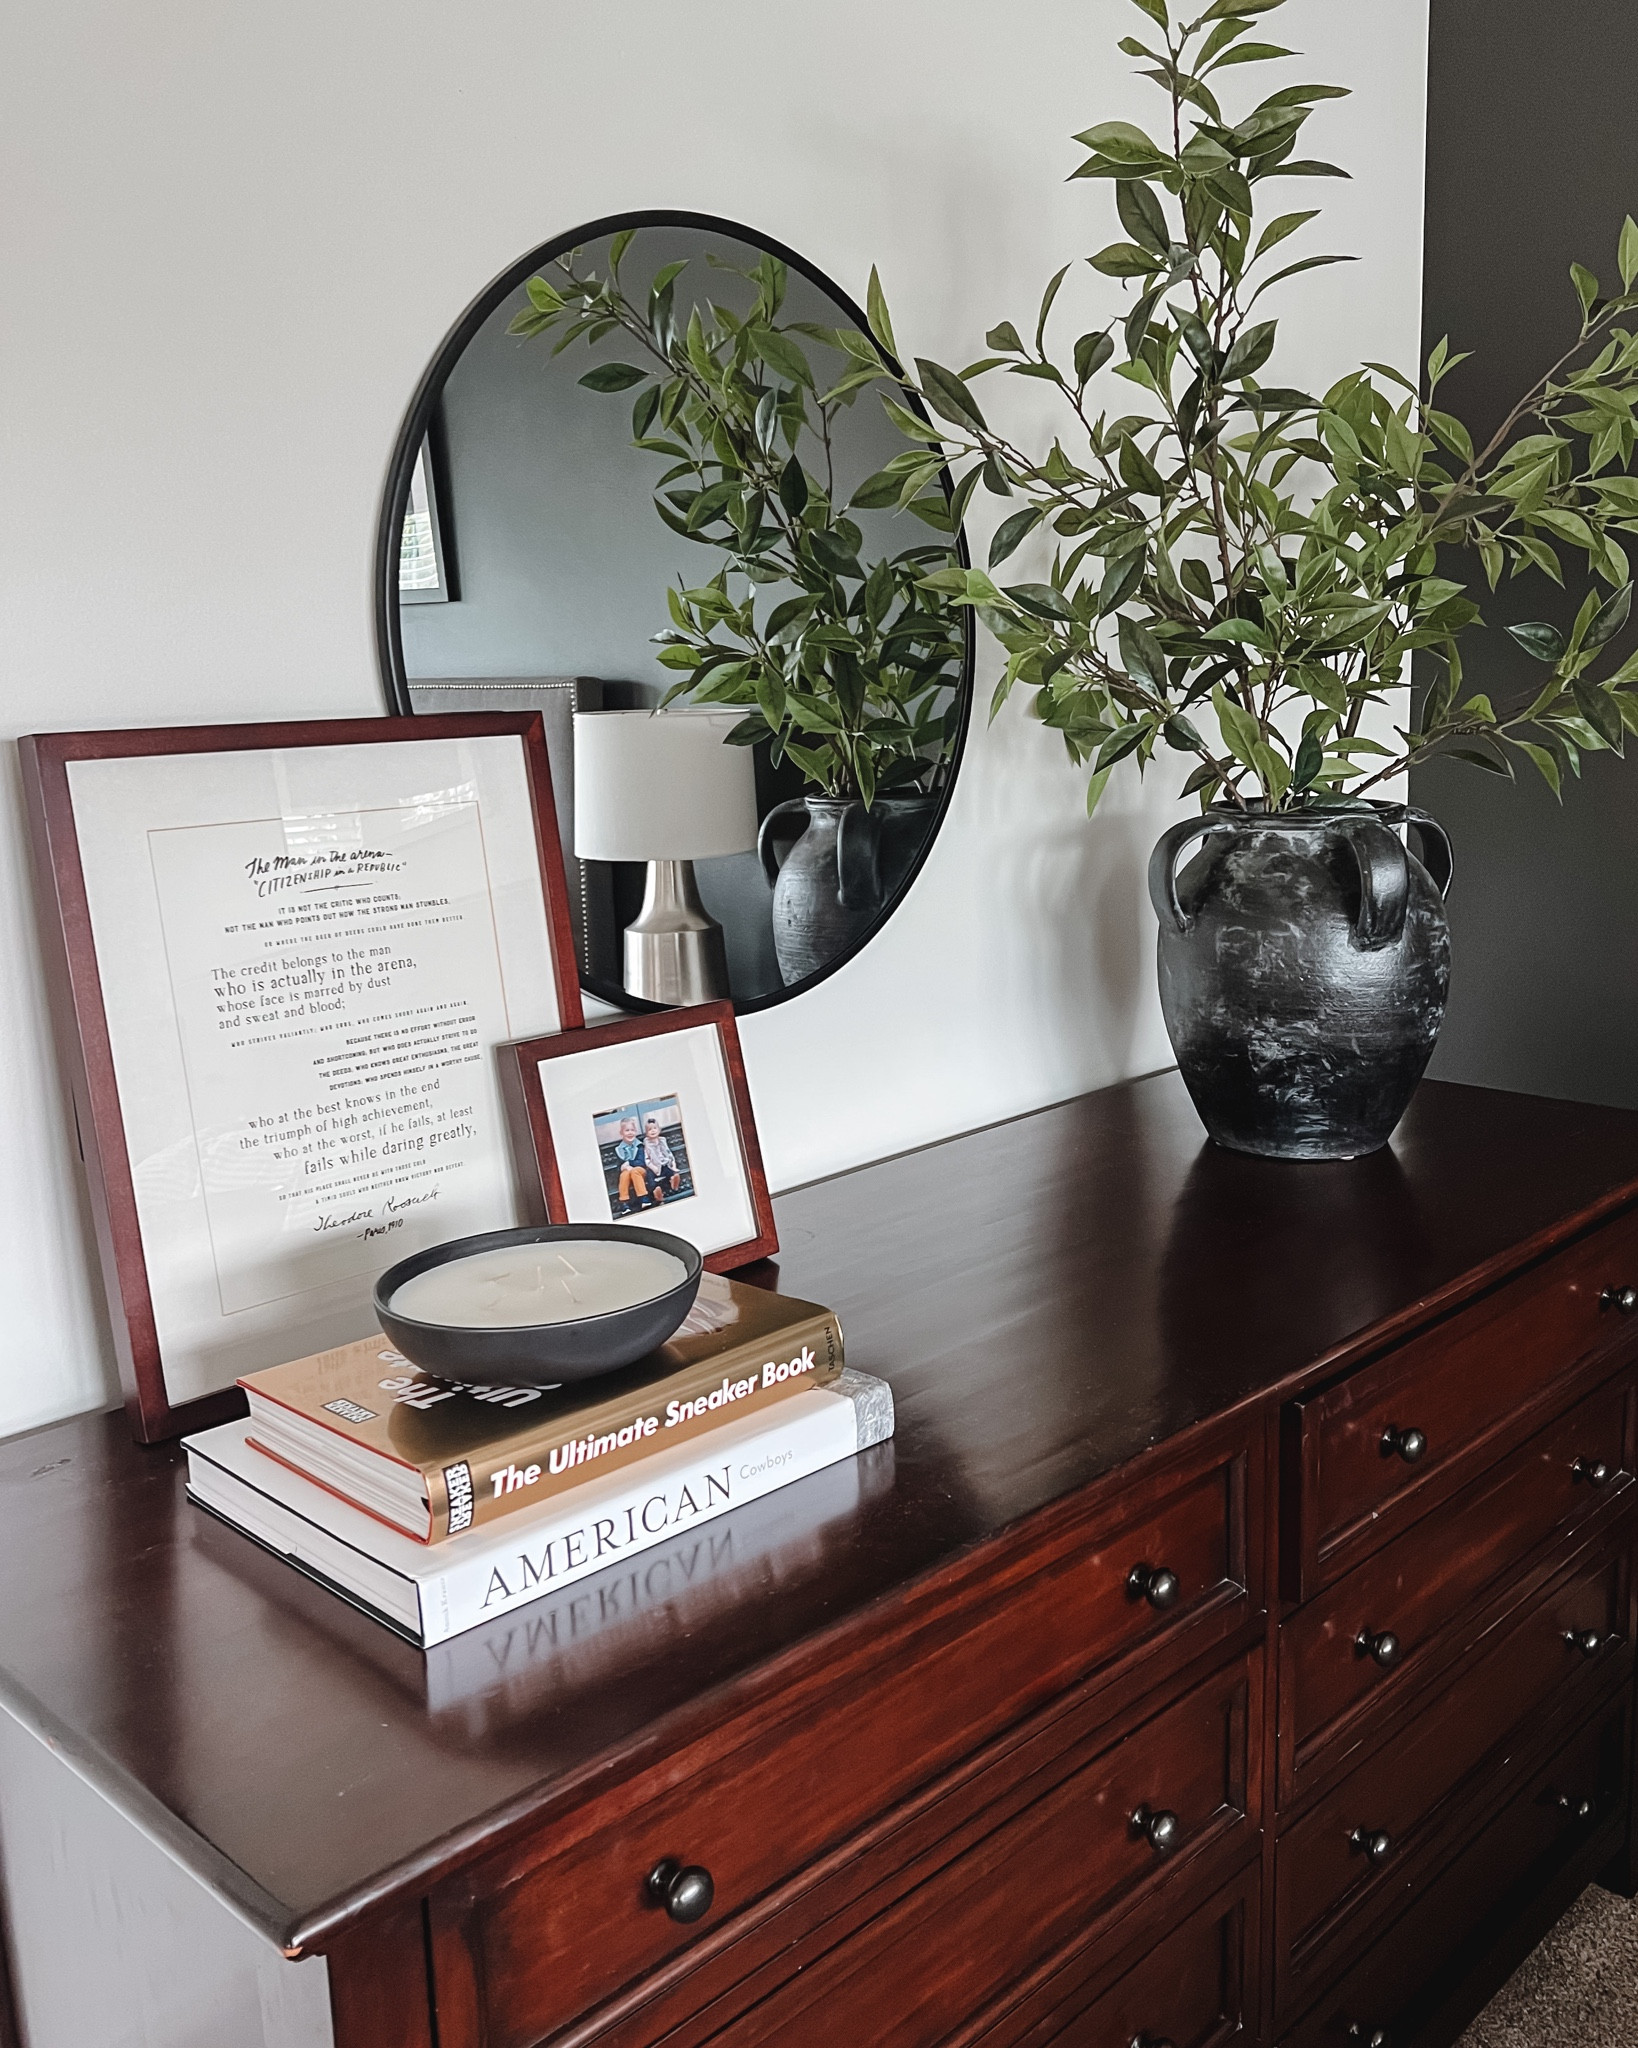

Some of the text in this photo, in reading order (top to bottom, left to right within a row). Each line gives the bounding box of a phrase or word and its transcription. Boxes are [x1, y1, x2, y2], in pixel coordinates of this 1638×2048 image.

[245, 857, 270, 879] The
[273, 856, 308, 871] Man
[333, 869, 346, 877] in
[224, 925, 239, 933] NOT
[241, 922, 257, 931] THE
[276, 918, 293, 926] WHO
[294, 914, 321, 924] POINTS
[322, 912, 336, 920] OUT
[338, 910, 354, 918] HOW
[372, 904, 398, 914] STRONG
[399, 902, 414, 910] MAN
[297, 904, 311, 912] NOT
[314, 902, 328, 910] THE
[330, 899, 353, 908] CRITIC
[354, 897, 371, 905] WHO
[210, 946, 391, 983] The credit belongs to the man
[213, 958, 417, 997] who is actually in the arena,
[216, 976, 391, 1013] whose face is marred by dust
[218, 997, 346, 1030] and sweat and blood;
[345, 1034, 372, 1045] BECAUSE
[373, 1031, 392, 1040] THERE
[410, 1023, 431, 1033] EFFORT
[432, 1018, 457, 1028] WITHOUT
[458, 1015, 476, 1024] ERROR
[318, 1070, 331, 1078] THE
[354, 1063, 369, 1071] WHO
[370, 1059, 390, 1068] KNOWS
[391, 1054, 409, 1064] GREAT
[462, 1041, 478, 1050] GREAT
[368, 1047, 380, 1055] BUT
[382, 1044, 396, 1052] WHO
[396, 1041, 412, 1050] DOES
[413, 1035, 440, 1046] ACTUALLY
[441, 1031, 460, 1040] STRIVE
[364, 1075, 378, 1083] WHO
[379, 1070, 402, 1080] SPENDS
[402, 1065, 426, 1075] HIMSELF
[440, 1058, 462, 1067] WORTHY
[248, 1078, 440, 1129] who at the best knows in the end
[239, 1098, 433, 1150] the triumph of high achievement,
[272, 1105, 473, 1160] who at the worst, if he fails, at least
[304, 1123, 476, 1175] fails while daring greatly,
[824, 1326, 835, 1373] TASCHEN
[378, 1376, 456, 1410] The
[490, 1346, 816, 1498] The Ultimate Sneaker Book
[479, 1465, 732, 1610] AMERICAN
[739, 1448, 793, 1481] Cowboys
